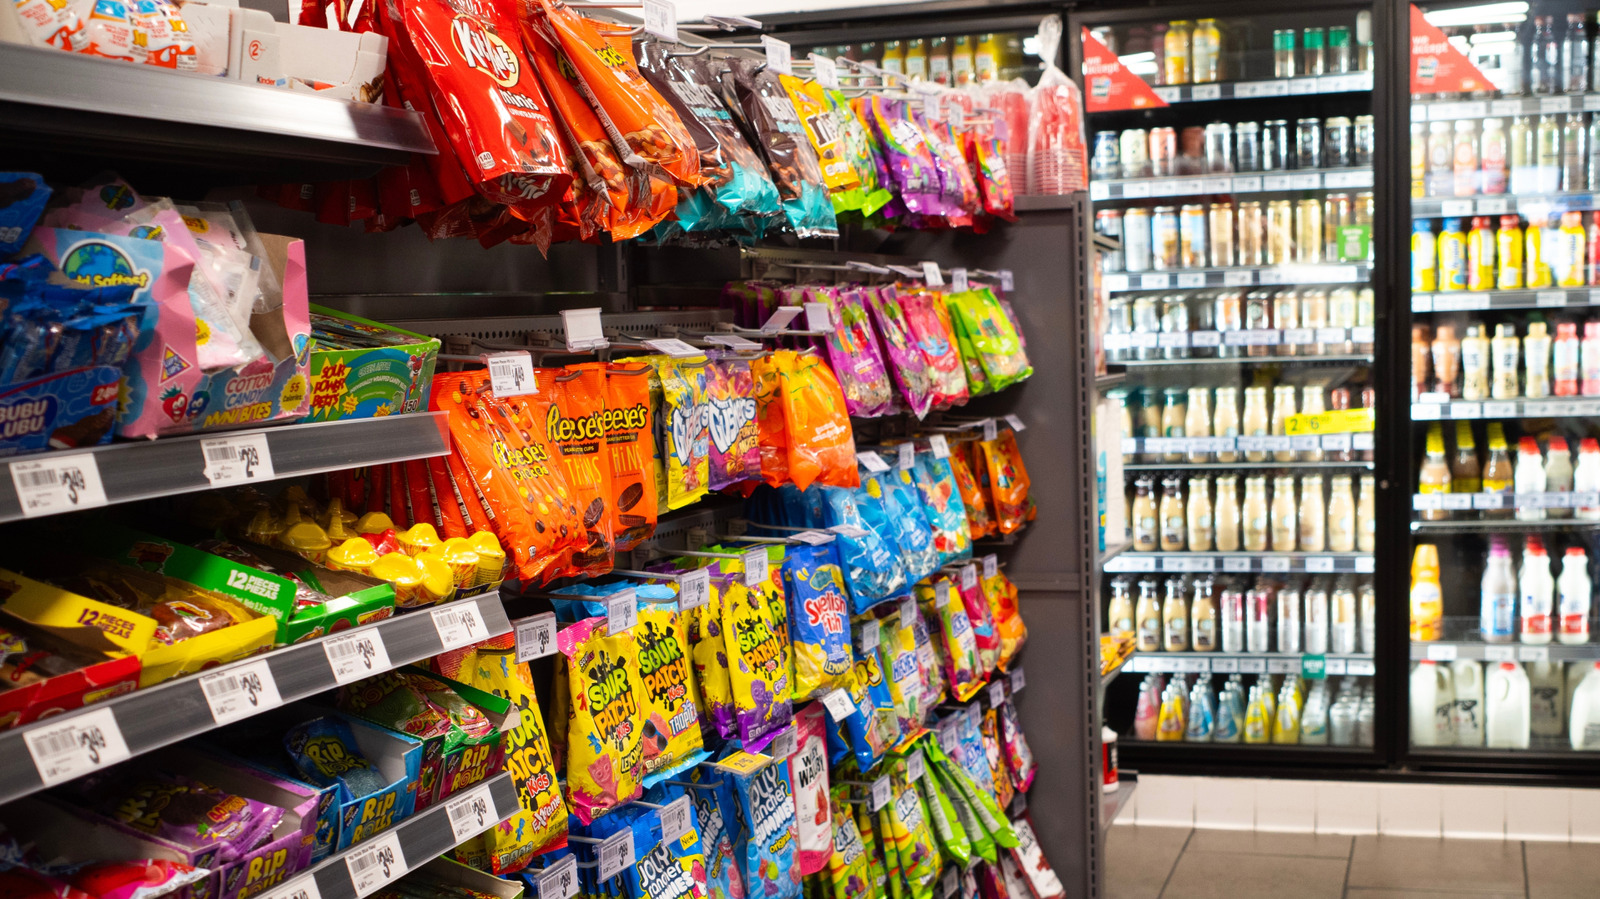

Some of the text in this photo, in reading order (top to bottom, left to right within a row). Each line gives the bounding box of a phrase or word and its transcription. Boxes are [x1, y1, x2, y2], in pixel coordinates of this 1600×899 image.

[226, 372, 275, 394] COTTON
[321, 364, 347, 380] SOUR
[226, 388, 265, 409] CANDY
[289, 382, 300, 393] 55
[314, 378, 346, 395] POWER
[240, 401, 272, 423] BITES
[313, 393, 340, 409] BELTS
[404, 400, 417, 412] 150
[547, 403, 604, 442] Reese's
[602, 404, 648, 430] eese's
[493, 440, 548, 470] Reese's
[226, 569, 281, 592] 12 PIECES
[244, 583, 279, 600] PIEZAS
[77, 608, 136, 631] 12 PIECES
[639, 637, 680, 674] SOUR
[588, 667, 627, 711] SOUR
[643, 656, 688, 699] PATCH
[667, 684, 685, 702] Kids
[594, 691, 635, 740] PATCH
[460, 743, 490, 772] Rip
[502, 735, 551, 784] ATCH
[450, 762, 488, 792] ROLLS
[526, 773, 549, 798] Kids
[360, 791, 396, 824] Rip
[352, 810, 393, 844] ROLLS
[245, 848, 288, 886] Rip
